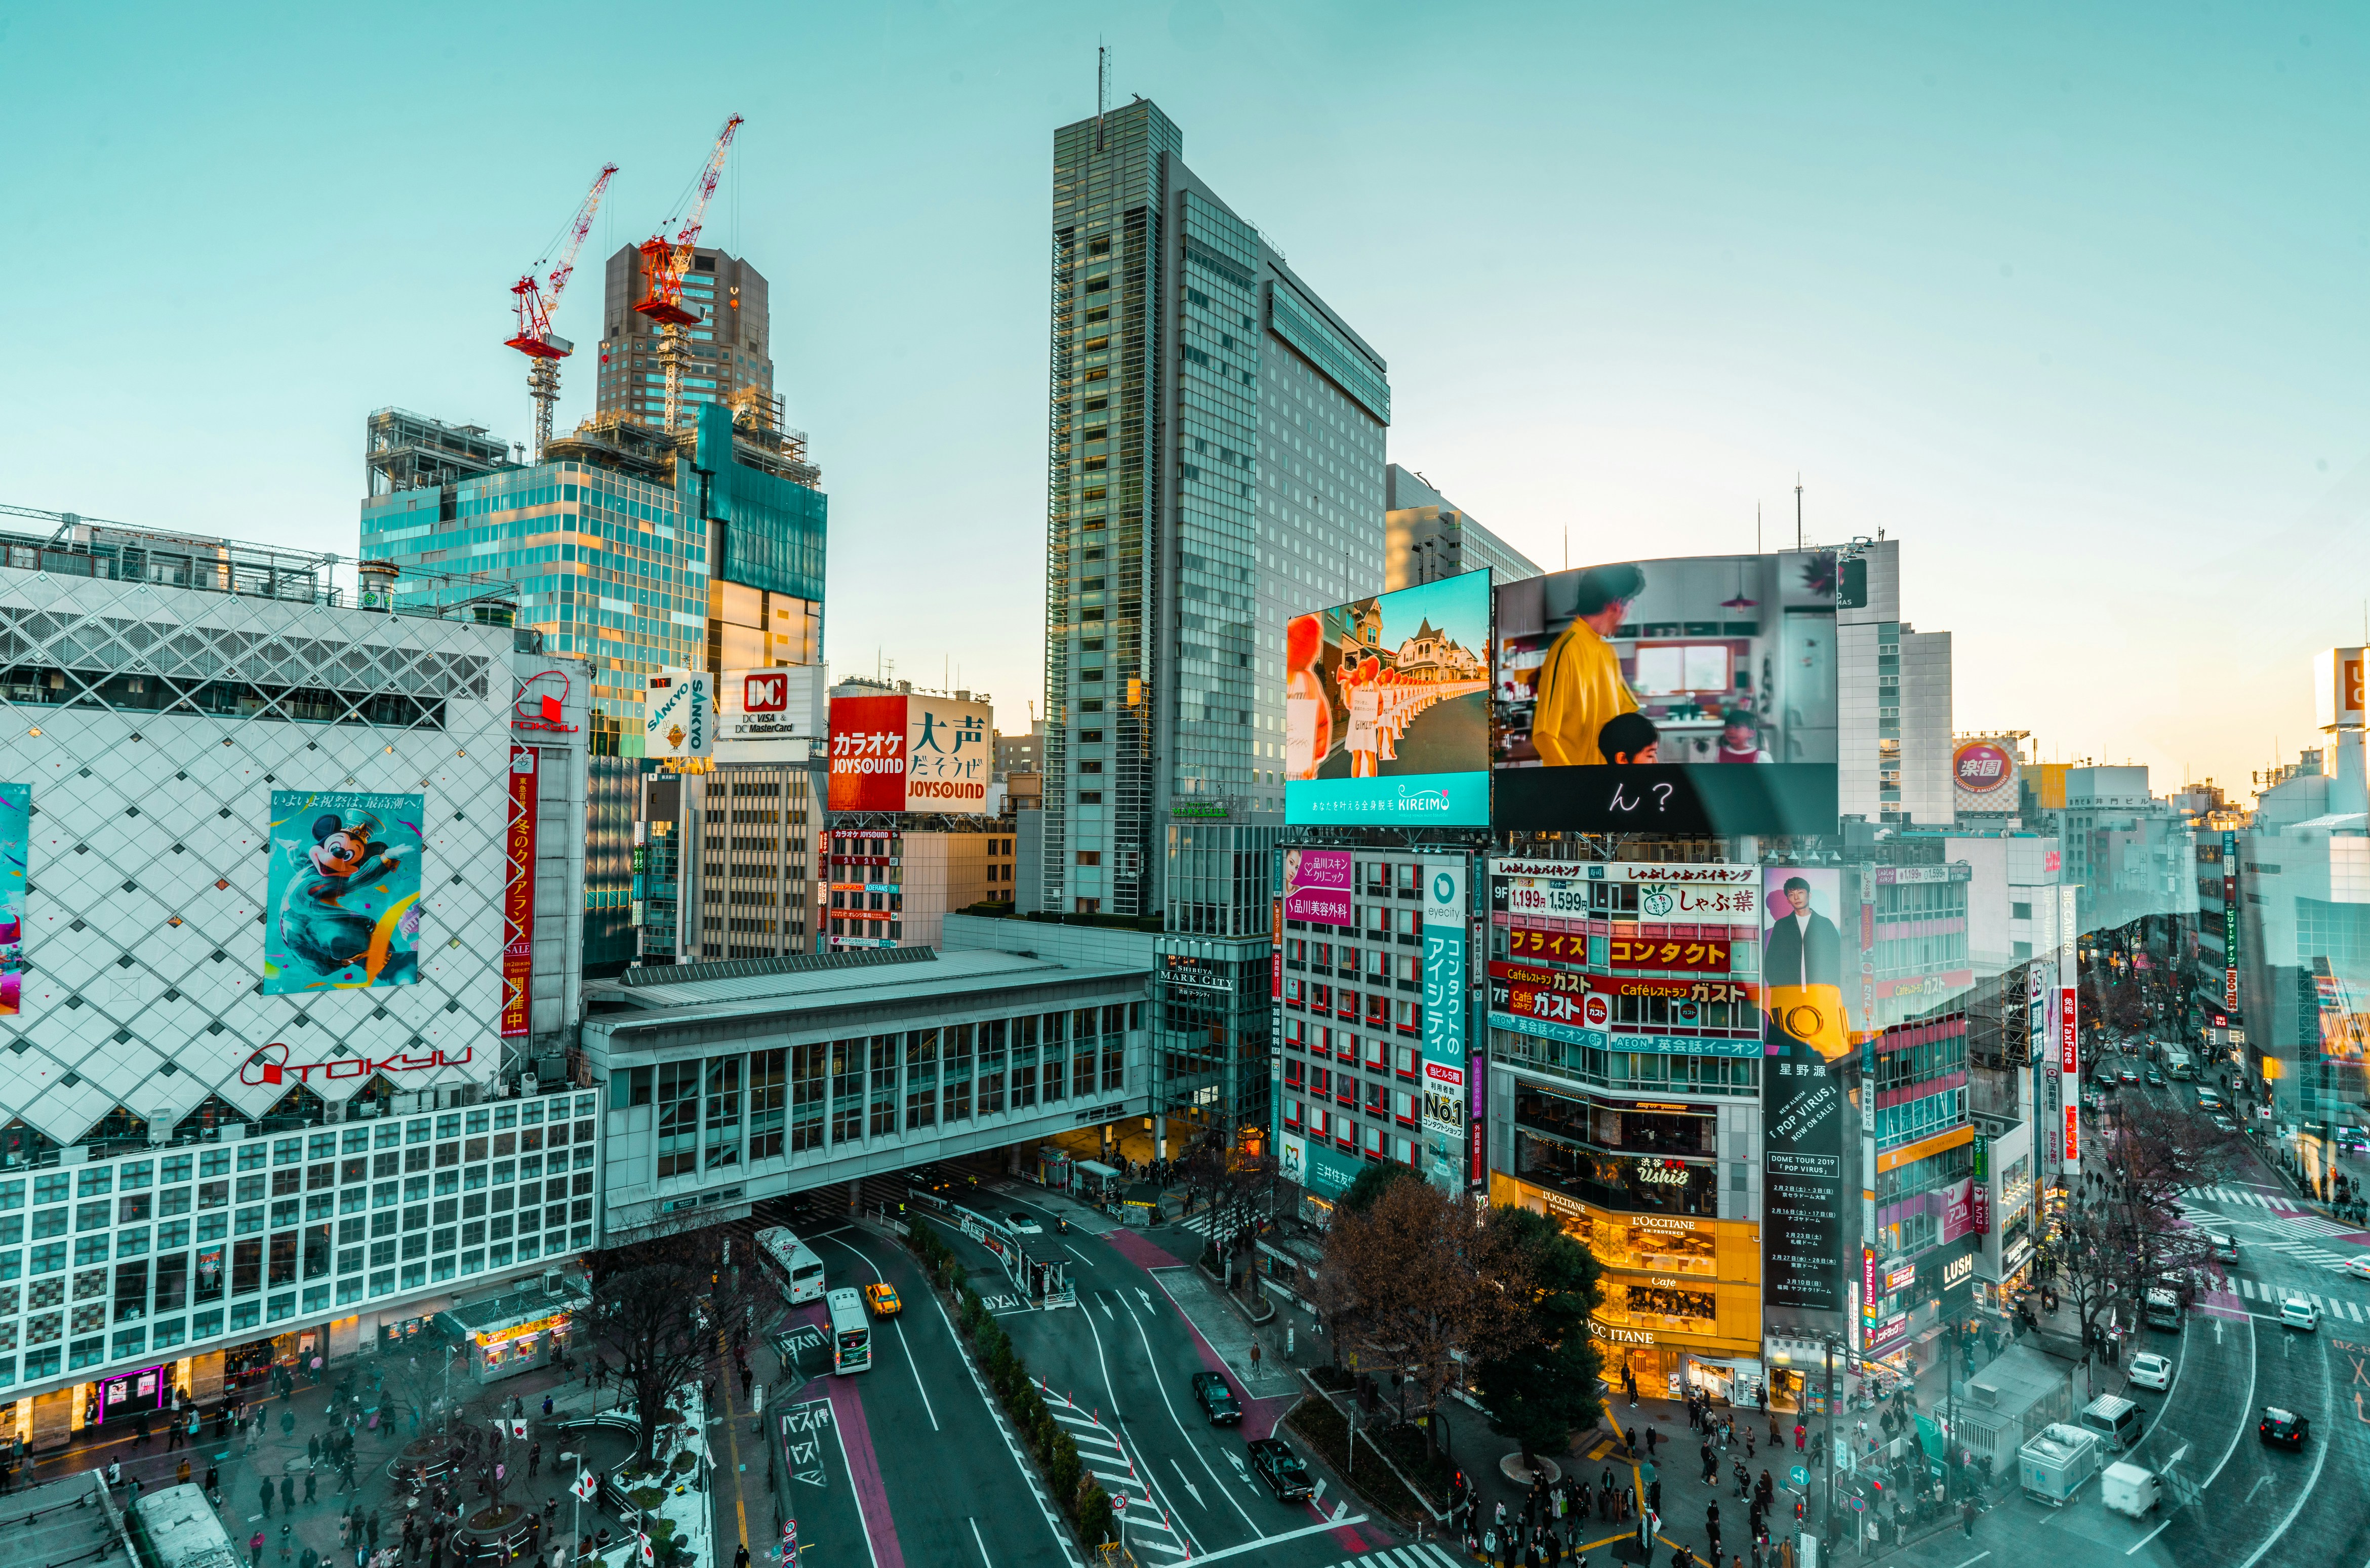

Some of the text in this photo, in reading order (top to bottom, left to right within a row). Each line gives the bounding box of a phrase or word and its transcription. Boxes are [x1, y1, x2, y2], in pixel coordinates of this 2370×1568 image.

[648, 682, 689, 732] SANKYO
[691, 679, 708, 749] SANKYO
[743, 714, 755, 723] DC
[757, 713, 775, 722] VISA
[735, 723, 793, 734] DC MasterCard
[910, 712, 985, 754] 大声
[833, 732, 903, 756] カラオケ
[833, 758, 903, 774] JOYSOUND
[909, 755, 985, 780] だそうぜ。
[1958, 759, 2002, 776] 楽園
[908, 781, 984, 799] JOYSOUND
[1953, 775, 2009, 793] EXCITING AMUSEMENT
[1312, 797, 1450, 811] あなたを叶える全身脱毛 KIREIMO
[1313, 858, 1347, 869] 品川スキン
[1499, 862, 1601, 876] しゃぶしゃぶバイキング 寿司
[1313, 871, 1344, 882] クリニック
[1628, 867, 1753, 881] しゃぶしゃぶバイキング
[1495, 887, 1508, 899] 9F
[1512, 890, 1546, 909] 1,199円
[1549, 891, 1587, 911] 1,599円
[1680, 890, 1754, 912] しゃぶ葉
[1294, 899, 1347, 918] 品川美容外科
[1428, 907, 1460, 921] eyecity
[2063, 891, 2073, 956] BIC CAMERA
[1511, 931, 1585, 957] プライス
[2227, 910, 2235, 962] ビリヤード・ダーツ
[505, 945, 530, 955] SALE
[1612, 943, 1725, 964] コンタクト
[1160, 971, 1233, 987] MARK CITY
[1178, 966, 1212, 975] SHIBUYA
[1553, 972, 1591, 994] ガスト
[1924, 976, 1945, 995] ガスト
[2227, 972, 2237, 1011] HOOTERS
[507, 977, 525, 1027] 開催中
[1428, 937, 1444, 1051] アイシティ
[1447, 940, 1459, 1055] コンタクトの
[1493, 987, 1509, 1002] 7F
[1513, 990, 1532, 1003] Café
[1691, 983, 1745, 1003] ガスト
[1513, 1003, 1532, 1011] レストラン
[1534, 992, 1580, 1020] ガスト
[1589, 1009, 1605, 1017] ガスト
[1491, 1015, 1512, 1027] AEON
[1518, 1019, 1585, 1041] 英会話イーオン
[2064, 998, 2074, 1064] 免税 TaxFree
[1615, 1038, 1759, 1055] AEON 英会話イーオン
[284, 1047, 472, 1082] TOKYU
[1779, 1063, 1826, 1077] 星野源
[1430, 1066, 1460, 1083] 当ビル5階
[1431, 1082, 1455, 1096] 利用者数
[2048, 1085, 2057, 1112] 調剤薬局
[1779, 1091, 1806, 1115] NEW ALBUM
[1423, 1118, 1463, 1136] コンタクトショップ
[1791, 1102, 1836, 1142] NOW ON SALE!
[1637, 1167, 1690, 1185] Ushi8
[1632, 1216, 1695, 1230] L'OCCITANE
[1949, 1202, 1967, 1236] アコム 3F
[1944, 1253, 1972, 1284] LUSH
[1652, 1277, 1676, 1288] Café
[782, 1409, 829, 1435] バス停
[786, 1441, 816, 1464] バス
